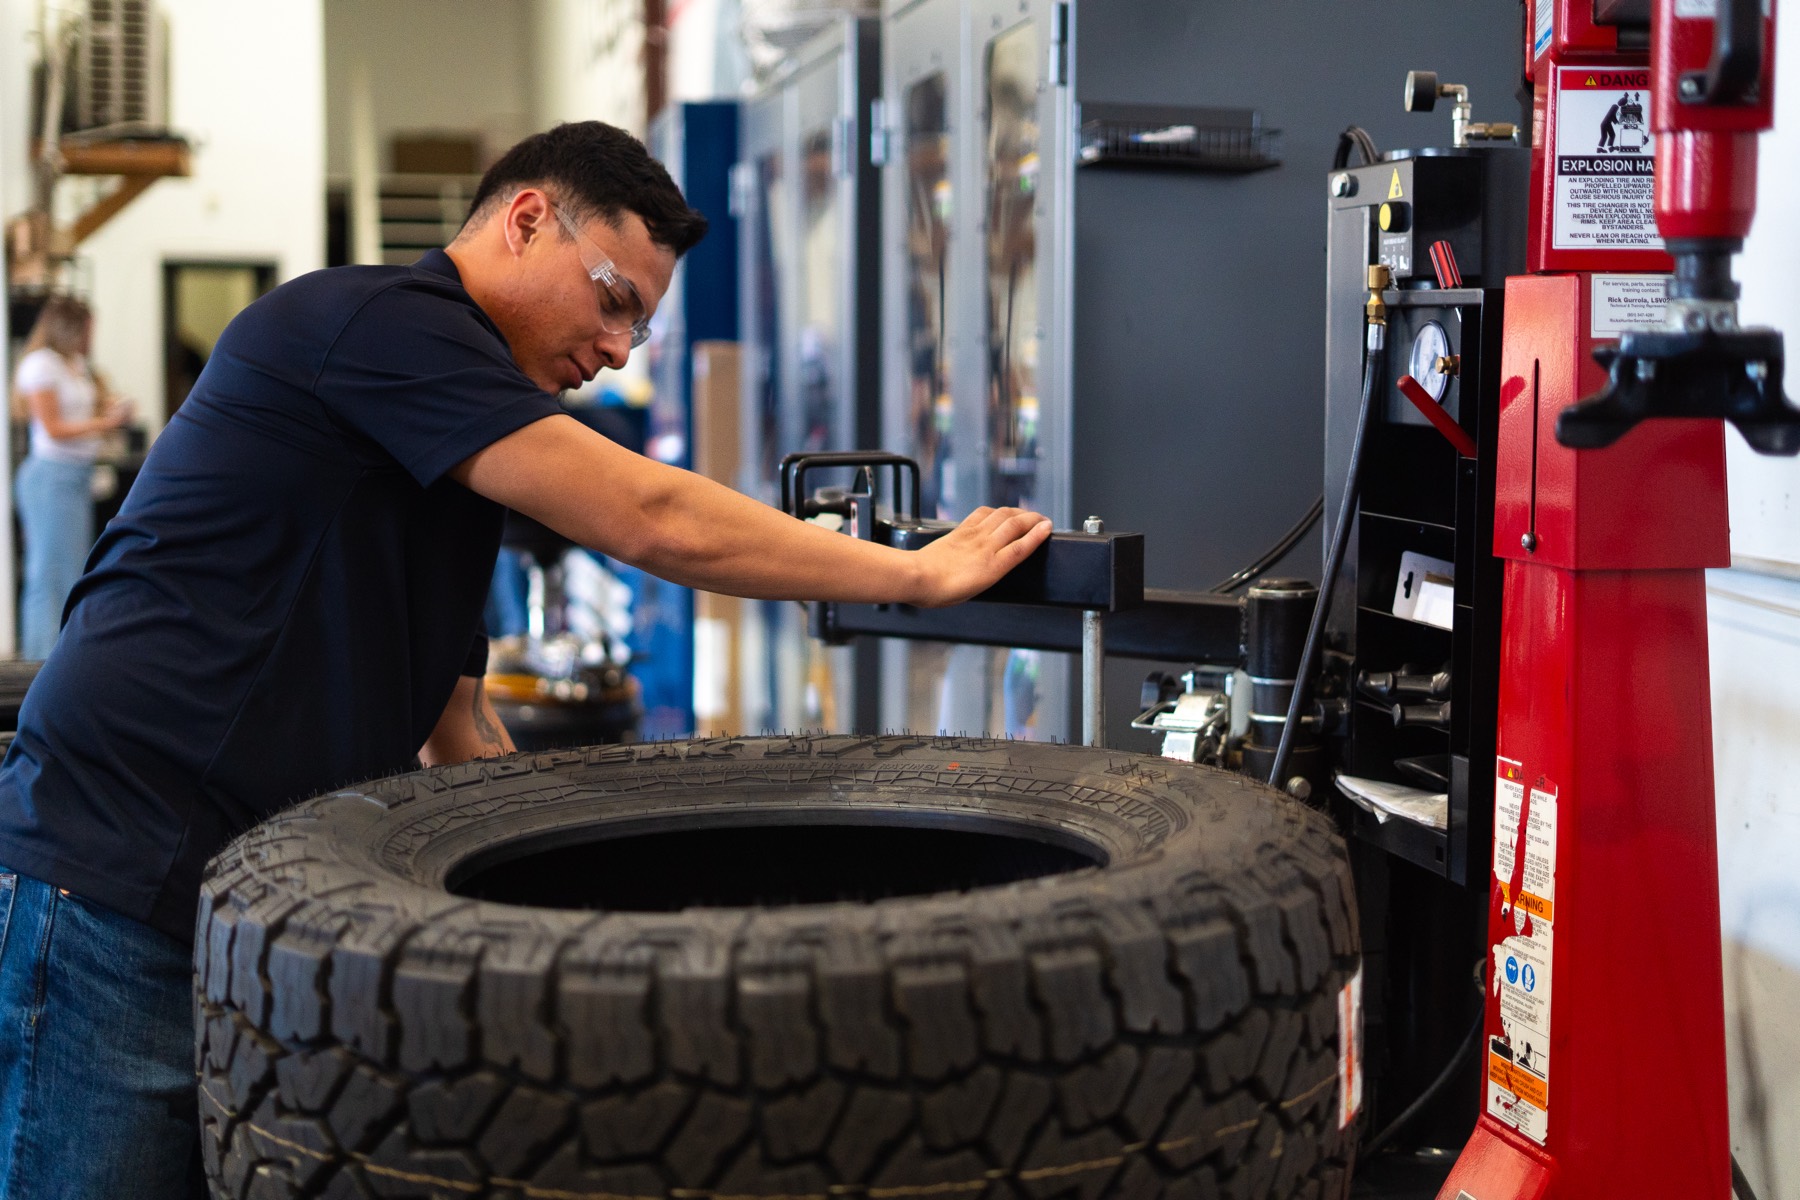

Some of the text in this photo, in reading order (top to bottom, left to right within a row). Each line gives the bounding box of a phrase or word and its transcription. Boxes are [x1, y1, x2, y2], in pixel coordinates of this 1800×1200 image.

[1600, 74, 1648, 87] DANG
[1562, 159, 1632, 171] EXPLOSION
[1514, 768, 1545, 789] DAER
[1517, 893, 1543, 913] RNING
